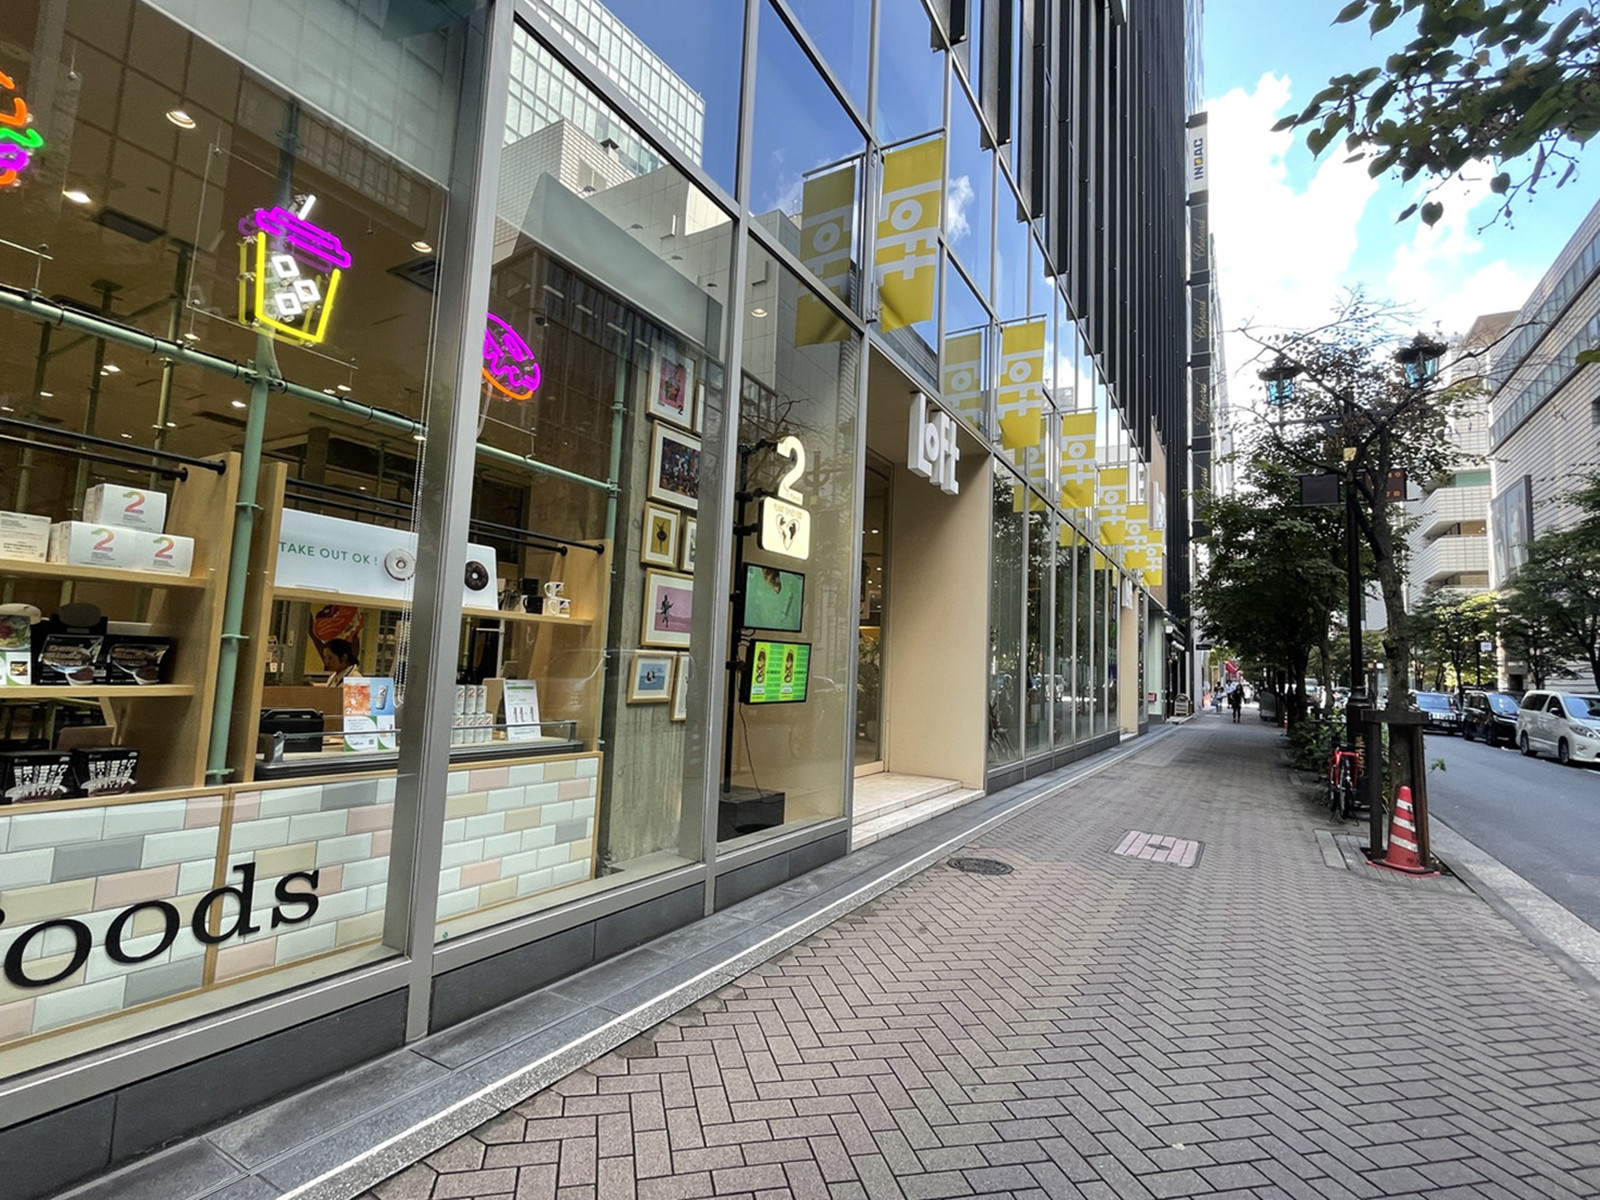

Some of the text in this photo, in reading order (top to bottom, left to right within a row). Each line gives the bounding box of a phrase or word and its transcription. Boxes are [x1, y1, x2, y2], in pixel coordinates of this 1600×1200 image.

[777, 435, 806, 506] 2
[122, 491, 146, 515] 2
[91, 528, 116, 552] 2
[153, 536, 175, 560] 2
[278, 541, 315, 556] TAKE
[319, 548, 348, 560] OUT
[0, 862, 319, 988] oods
